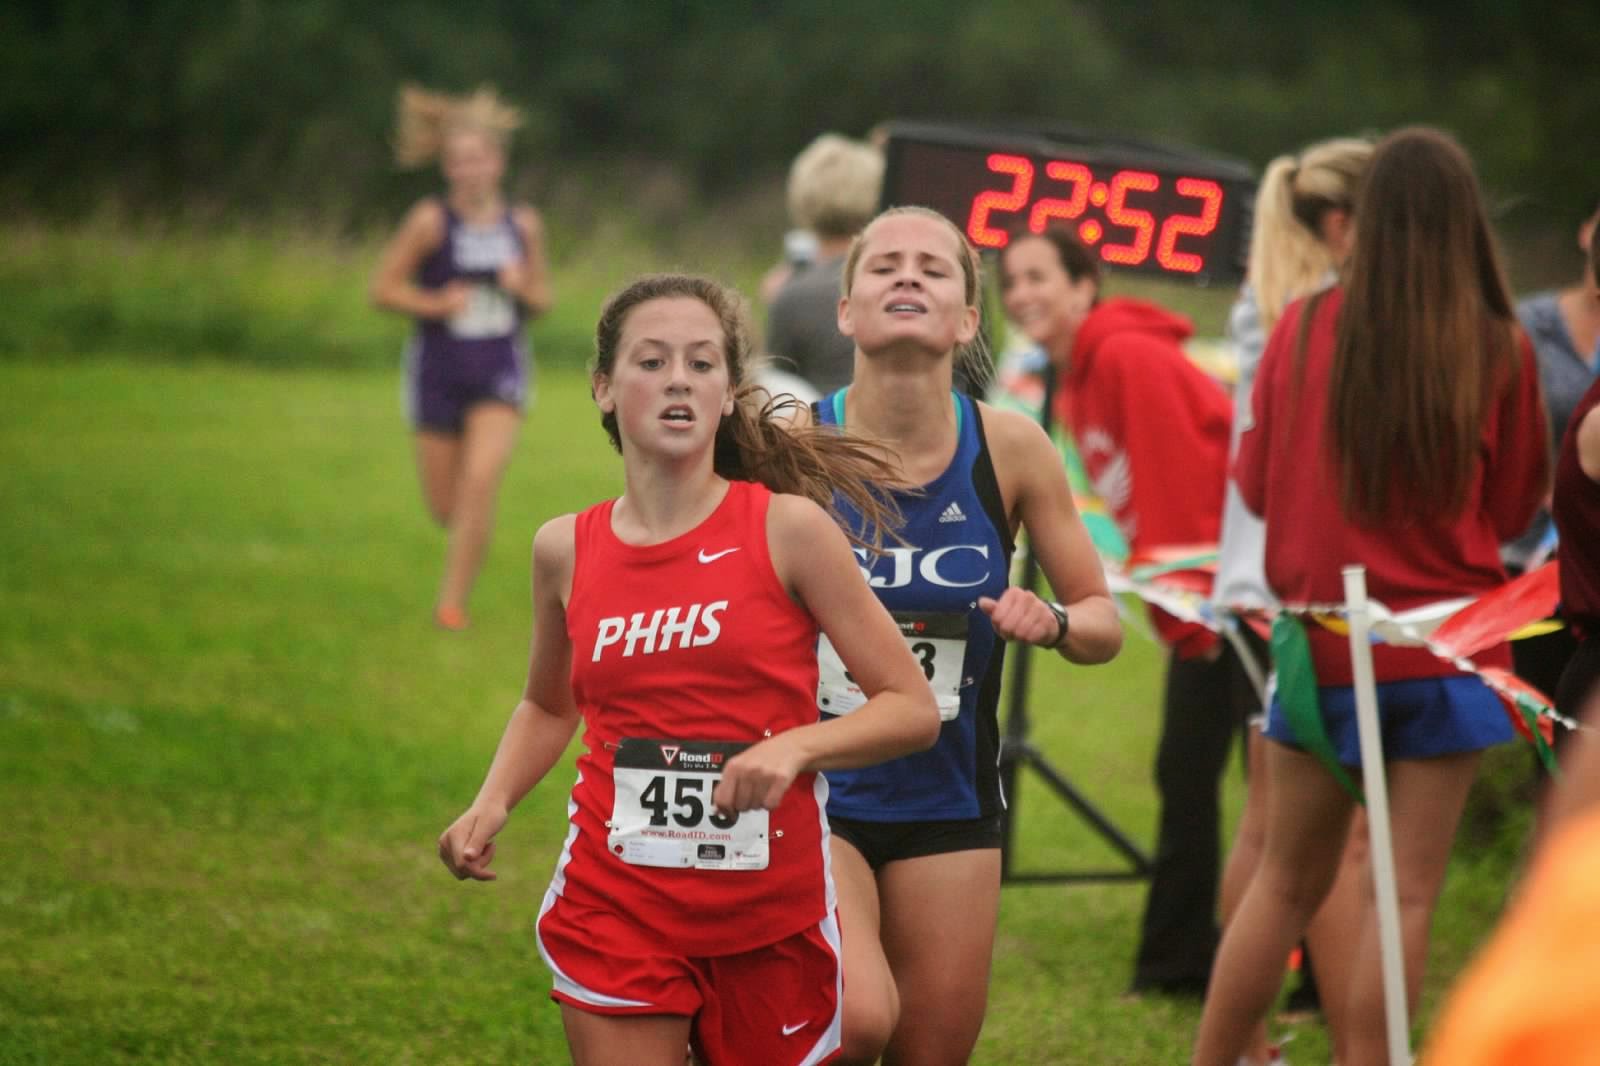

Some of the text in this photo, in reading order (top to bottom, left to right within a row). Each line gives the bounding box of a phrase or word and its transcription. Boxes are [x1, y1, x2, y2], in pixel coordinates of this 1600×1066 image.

[967, 153, 1223, 273] 22:52
[939, 514, 967, 523] adidas
[592, 600, 729, 662] PHHS
[640, 829, 732, 841] www.RoadID.com
